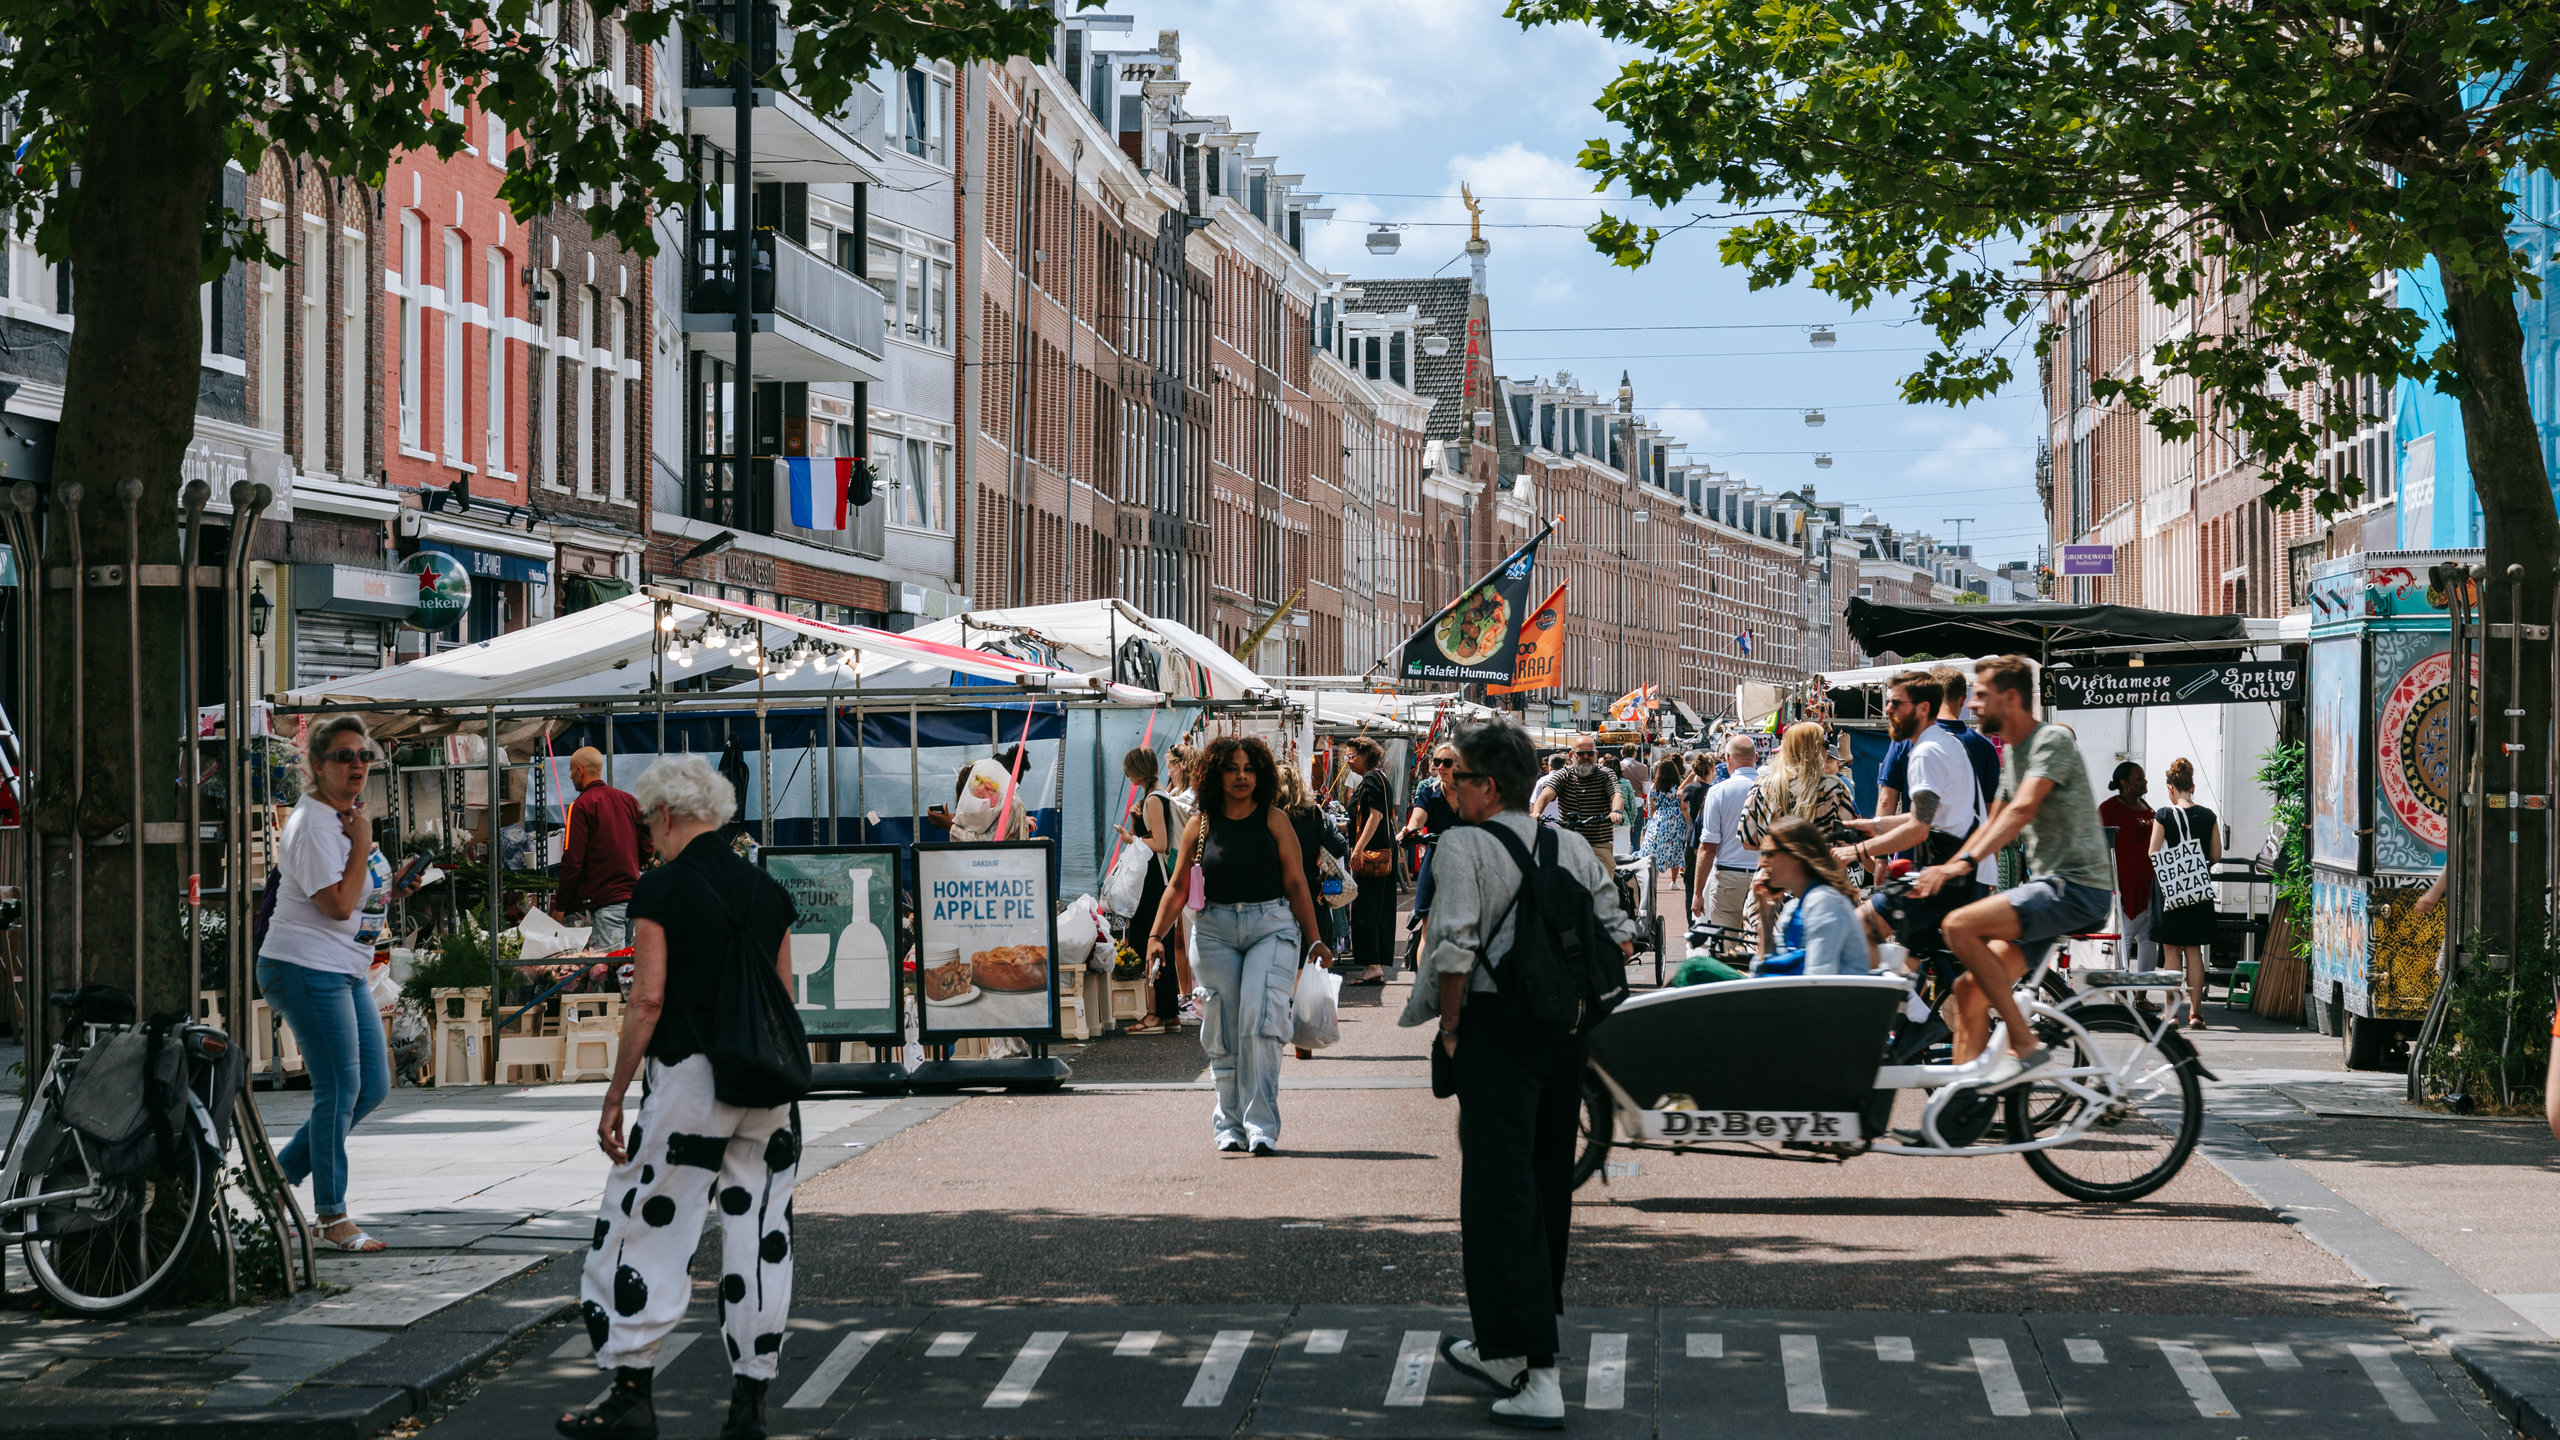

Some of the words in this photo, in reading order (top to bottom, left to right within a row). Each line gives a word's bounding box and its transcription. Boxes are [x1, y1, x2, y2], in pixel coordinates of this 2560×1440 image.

[1464, 318, 1481, 397] CAFE
[418, 597, 460, 609] neken
[1423, 664, 1459, 677] Falafel
[1460, 666, 1509, 681] Hummos
[2221, 668, 2296, 690] Spring
[2059, 673, 2171, 691] Vietnamese
[2229, 682, 2280, 699] Roll
[2082, 690, 2171, 706] Loempia
[933, 880, 1035, 898] HOMEMADE
[790, 891, 839, 907] ATUUR
[933, 900, 997, 920] APPLE
[1004, 899, 1035, 919] PIE
[1661, 1111, 1841, 1141] DrBeyk
